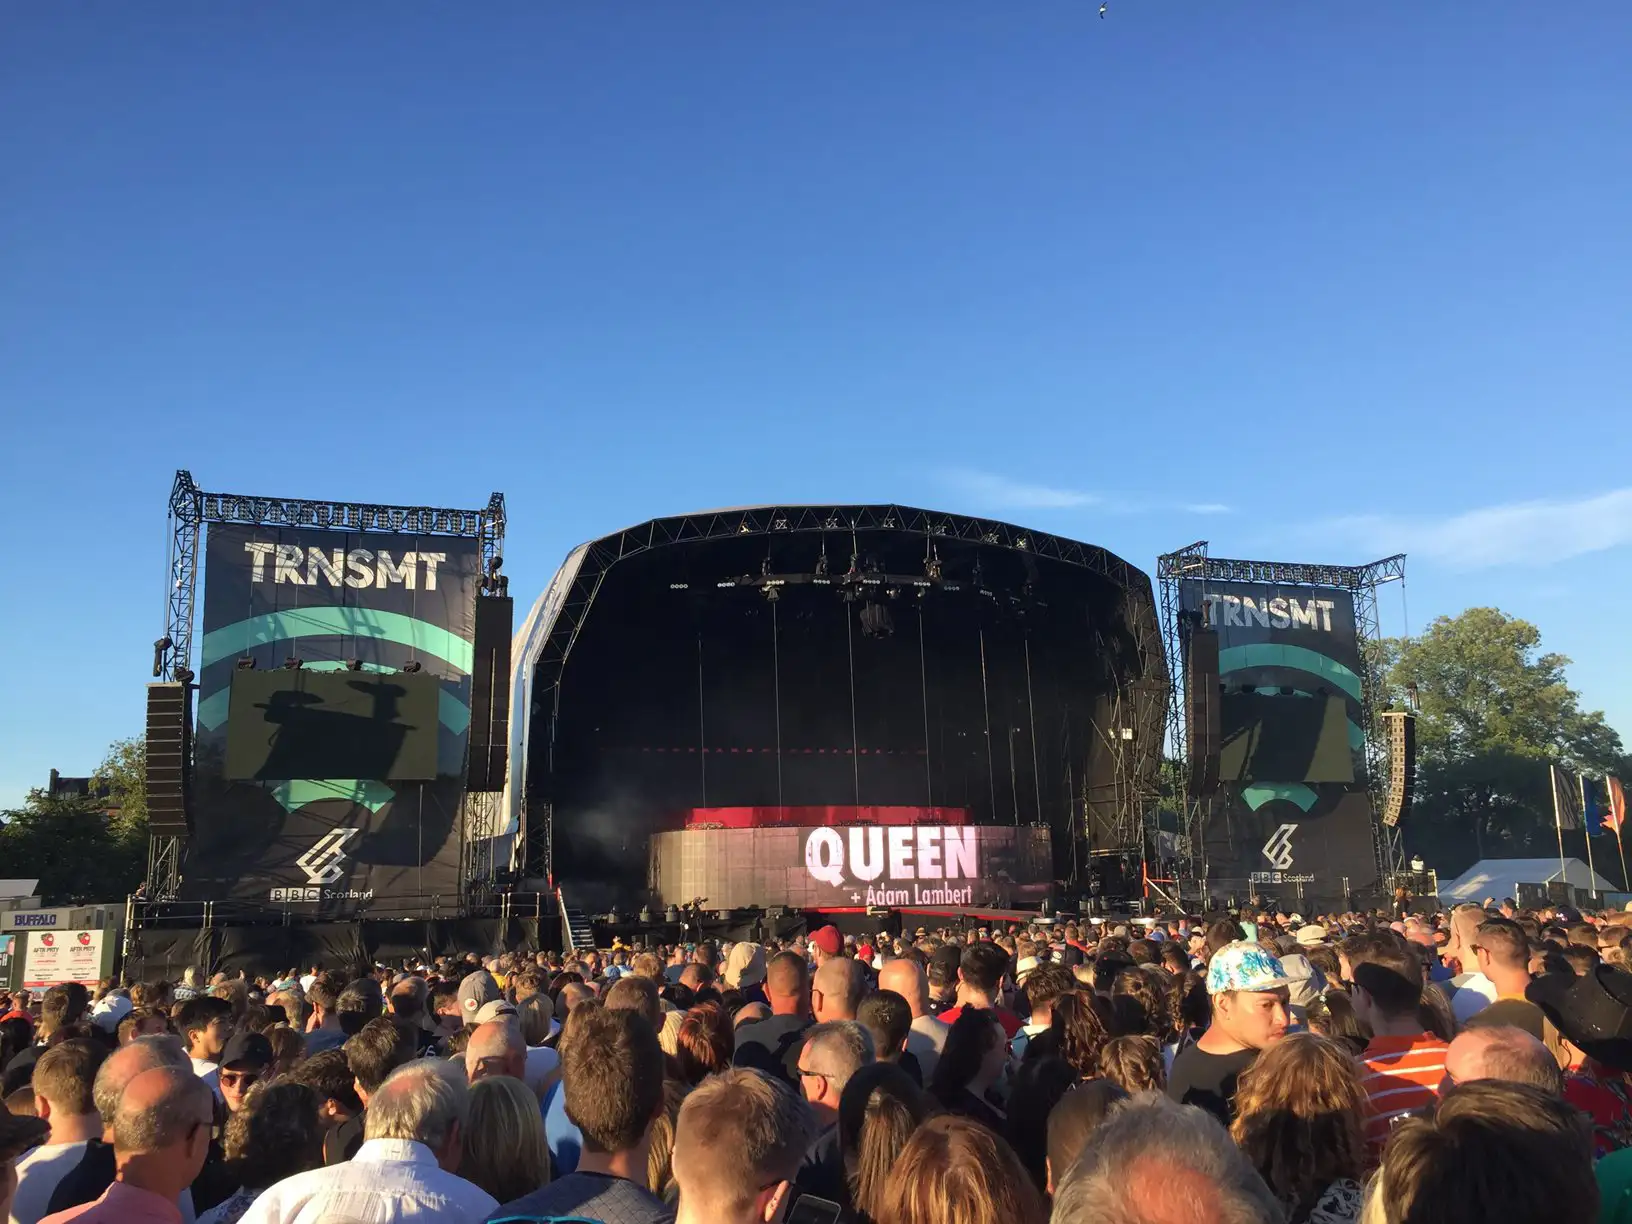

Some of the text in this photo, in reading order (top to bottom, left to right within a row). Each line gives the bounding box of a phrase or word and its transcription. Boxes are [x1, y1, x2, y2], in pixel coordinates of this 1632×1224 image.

[244, 541, 447, 591] TRNSMT
[1203, 593, 1335, 632] TRNSMT
[805, 826, 977, 887] QUEEN
[1251, 872, 1282, 883] BBC
[270, 888, 320, 901] BBC
[866, 883, 909, 906] Adam
[914, 881, 972, 905] Lambert
[15, 914, 57, 926] BUFFALO
